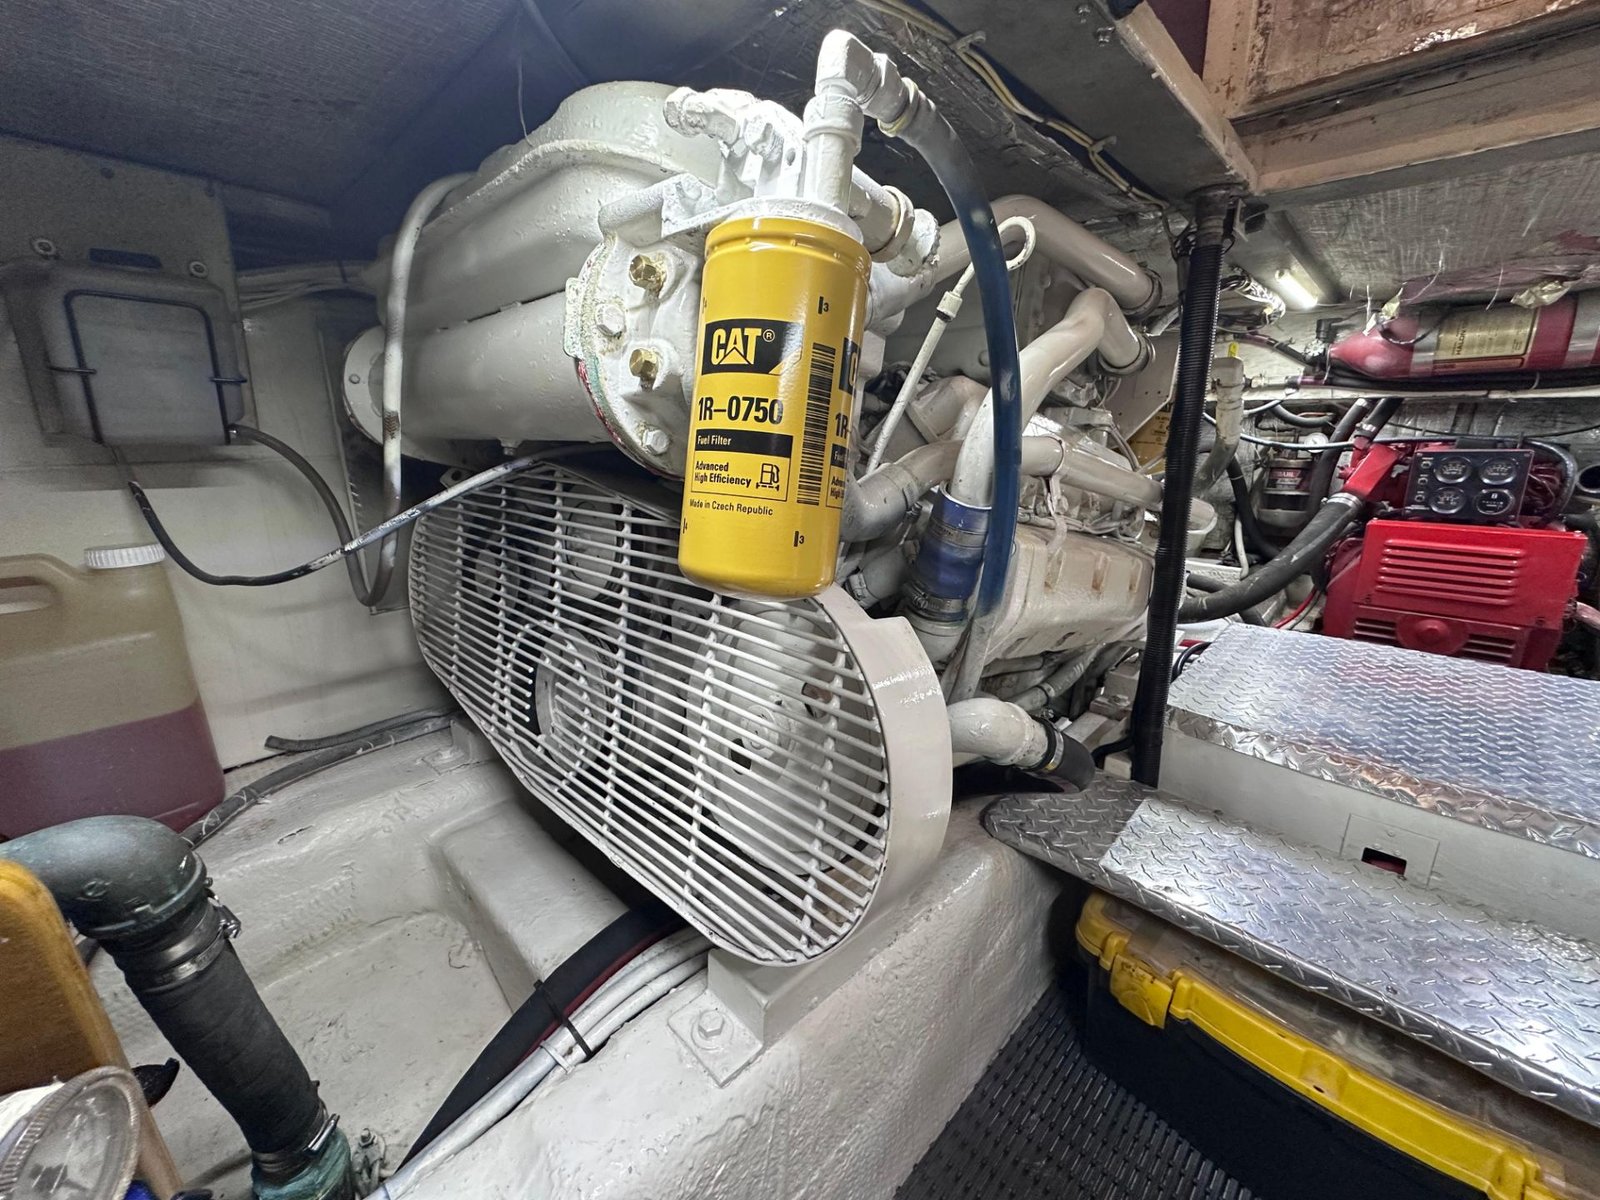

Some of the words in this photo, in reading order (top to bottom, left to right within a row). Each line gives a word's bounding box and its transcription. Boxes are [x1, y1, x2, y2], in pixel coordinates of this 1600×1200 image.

[698, 396, 783, 424] 1R-0750
[697, 435, 710, 445] Fuel
[711, 435, 732, 446] Filter
[695, 461, 729, 472] Advanced
[694, 472, 708, 483] High
[709, 473, 752, 488] Efficiency
[689, 499, 703, 508] Made
[705, 500, 710, 508] in
[712, 501, 734, 511] Czech
[737, 504, 773, 516] Republic
